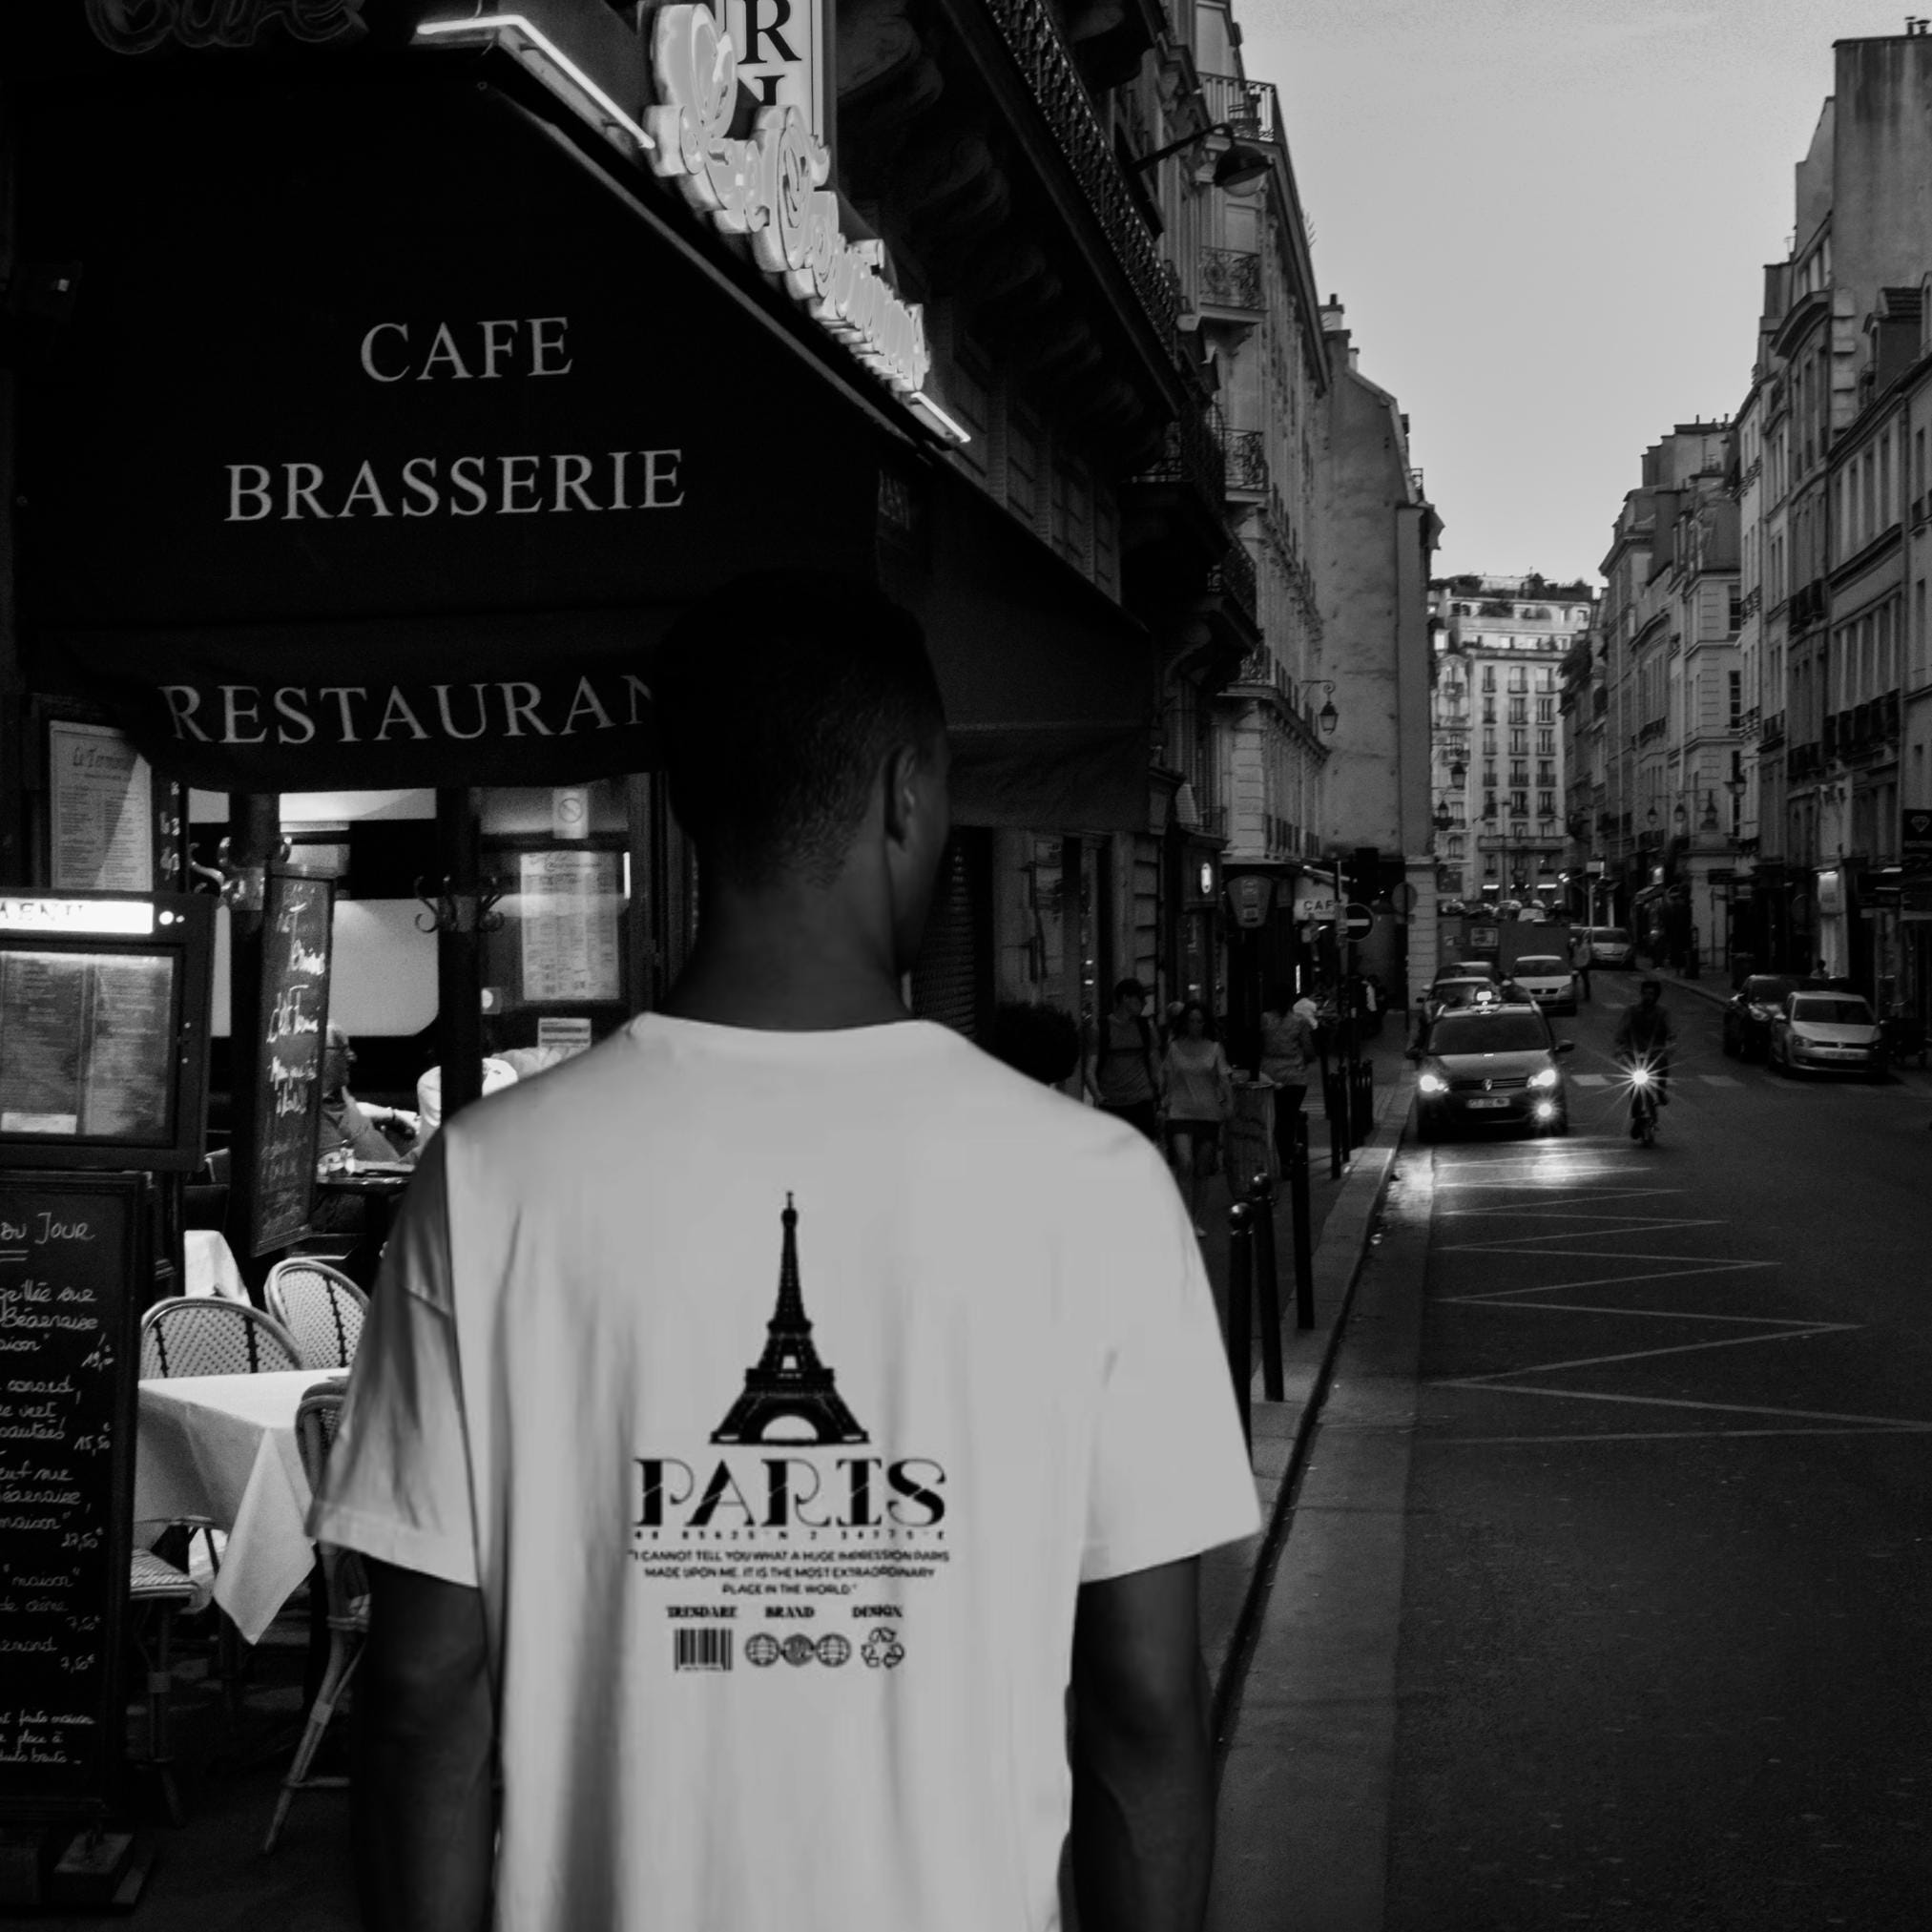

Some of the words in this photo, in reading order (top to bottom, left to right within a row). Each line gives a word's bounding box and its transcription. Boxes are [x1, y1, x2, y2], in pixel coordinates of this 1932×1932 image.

[360, 316, 573, 383] CAFE
[223, 447, 686, 522] BRASSERIE
[634, 1458, 946, 1527] PARIS
[696, 1549, 721, 1561] TELL
[725, 1549, 752, 1561] YOU
[753, 1549, 787, 1561] WHAT
[790, 1550, 800, 1560] A
[803, 1549, 835, 1561] HUGE
[644, 1567, 680, 1577] MADE
[683, 1567, 717, 1577] UPON
[770, 1567, 792, 1577] THE
[795, 1567, 829, 1577] MOST
[722, 1584, 761, 1594] PLACE
[764, 1584, 777, 1594] IN
[780, 1584, 800, 1594] THE
[765, 1606, 815, 1617] BRAND
